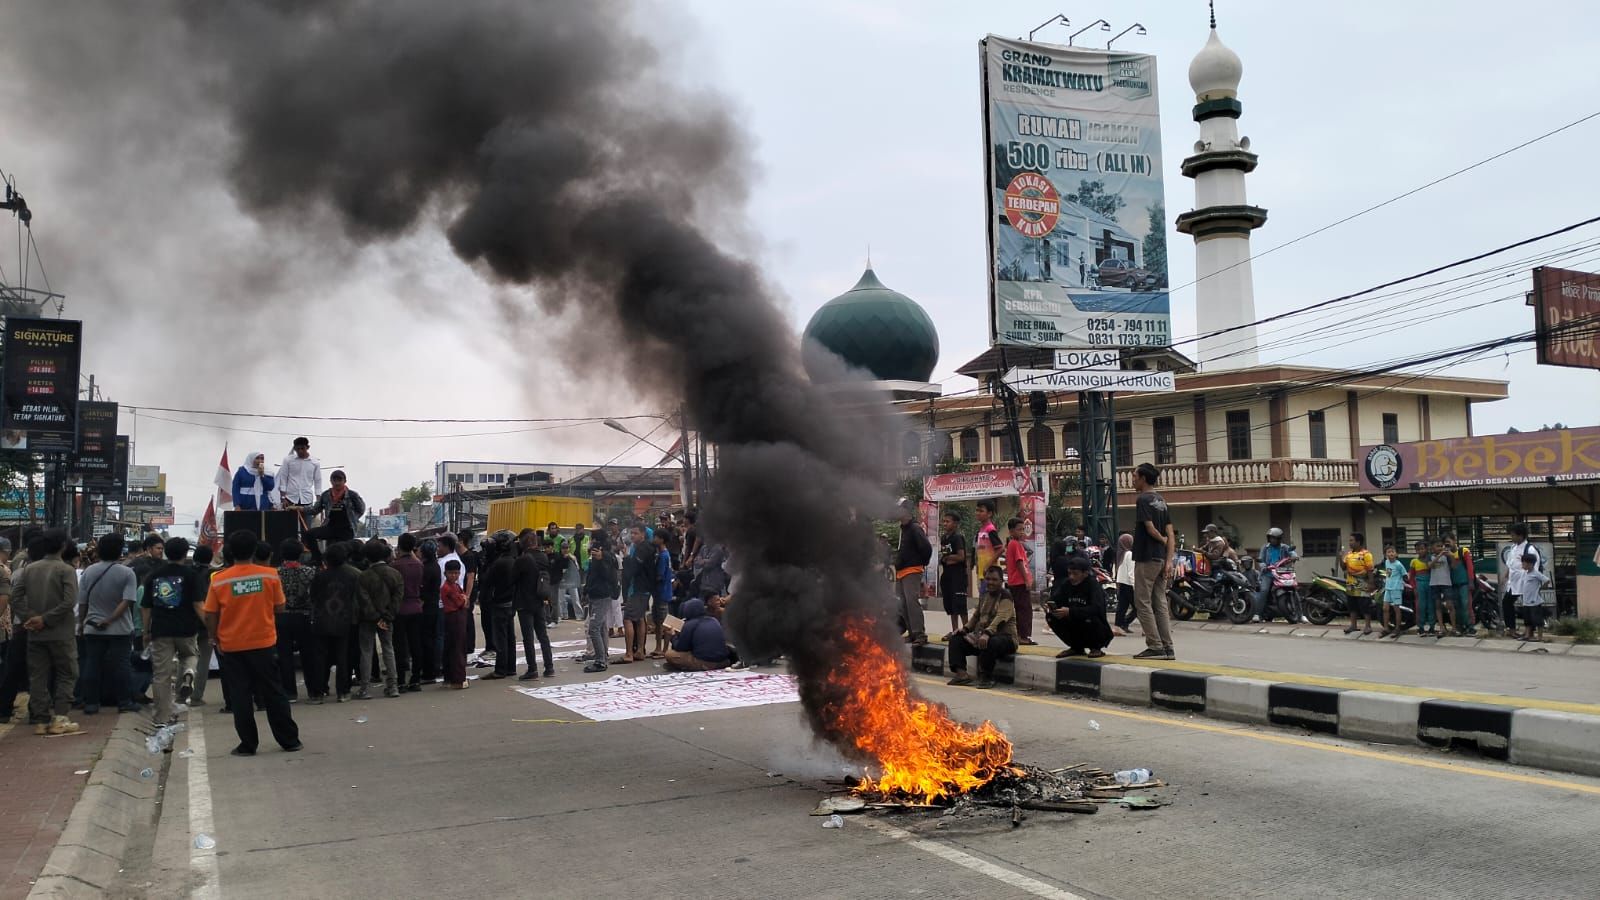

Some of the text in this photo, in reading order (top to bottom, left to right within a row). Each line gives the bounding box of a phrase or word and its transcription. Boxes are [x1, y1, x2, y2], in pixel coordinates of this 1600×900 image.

[1001, 49, 1052, 67] GRAND
[1002, 63, 1104, 92] KRAMATWATU
[1003, 84, 1056, 98] RESIDENCE
[1018, 113, 1081, 140] RUMAH
[1008, 140, 1050, 170] 500
[1055, 148, 1088, 171] ribu
[1013, 175, 1050, 193] LOKASI
[1007, 196, 1057, 214] TERDEPAN
[1016, 218, 1048, 235] KAMI
[1013, 320, 1056, 331] FREE BIAYA
[1087, 318, 1115, 331] 0254
[1123, 319, 1143, 332] 794
[14, 330, 75, 343] SIGNATURE
[1006, 331, 1031, 341] SURAT
[1038, 332, 1063, 342] SURAT
[1088, 333, 1167, 346] 0831 1733 2757
[1058, 352, 1118, 367] LOKASI
[1022, 373, 1172, 388] JL. WARINGIN KURUNG
[1413, 430, 1600, 480] Bebek
[1427, 479, 1484, 487] KRAMATWATU
[1510, 473, 1574, 483] KRAMATATU
